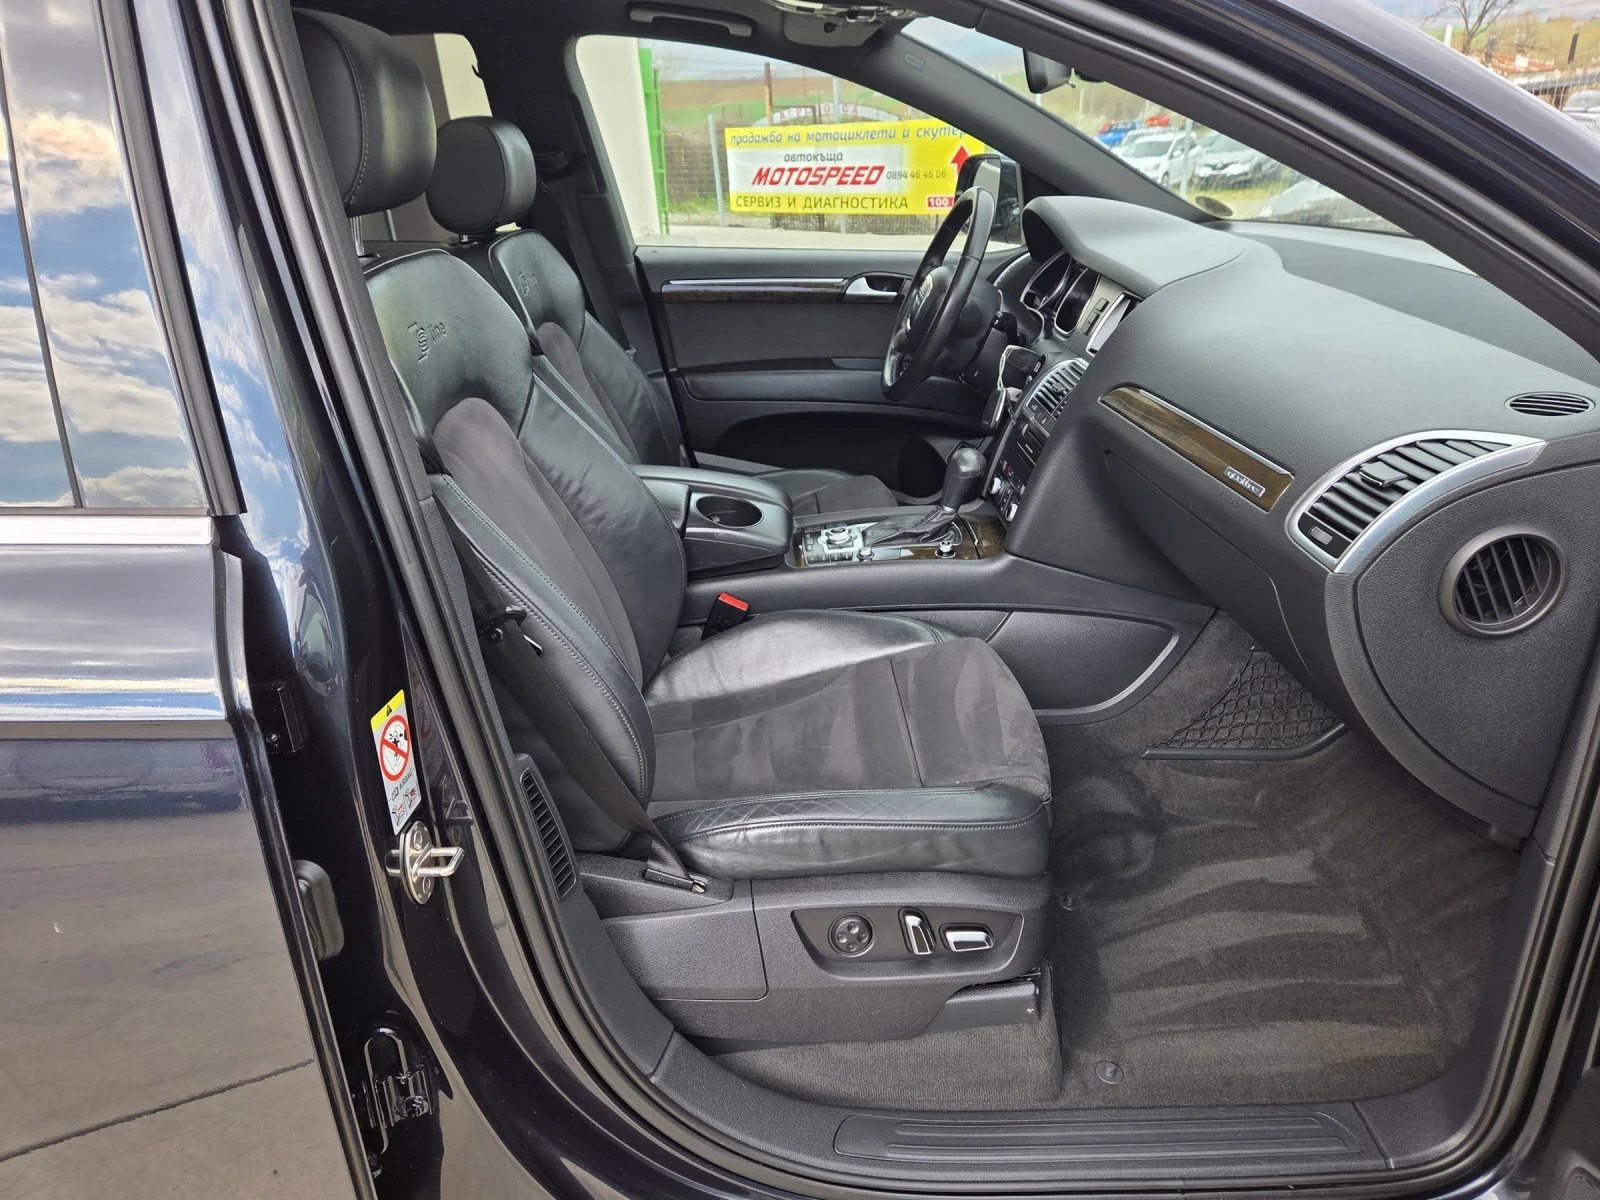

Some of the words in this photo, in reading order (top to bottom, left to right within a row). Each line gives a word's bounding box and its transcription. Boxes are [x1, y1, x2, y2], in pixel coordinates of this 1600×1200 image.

[730, 131, 783, 146] продажба
[787, 133, 801, 142] на
[806, 129, 896, 143] мотоциклети
[902, 128, 910, 138] и
[783, 152, 844, 164] автокъща
[752, 166, 885, 186] MOTOSPEED
[886, 170, 908, 180] 0894
[909, 170, 921, 179] 46
[922, 169, 934, 179] 46
[935, 169, 947, 178] 06
[736, 195, 781, 208] СЕРВИЗ
[787, 197, 796, 208] И
[803, 196, 909, 211] ДИАГНОСТИКА
[929, 197, 949, 206] 100
